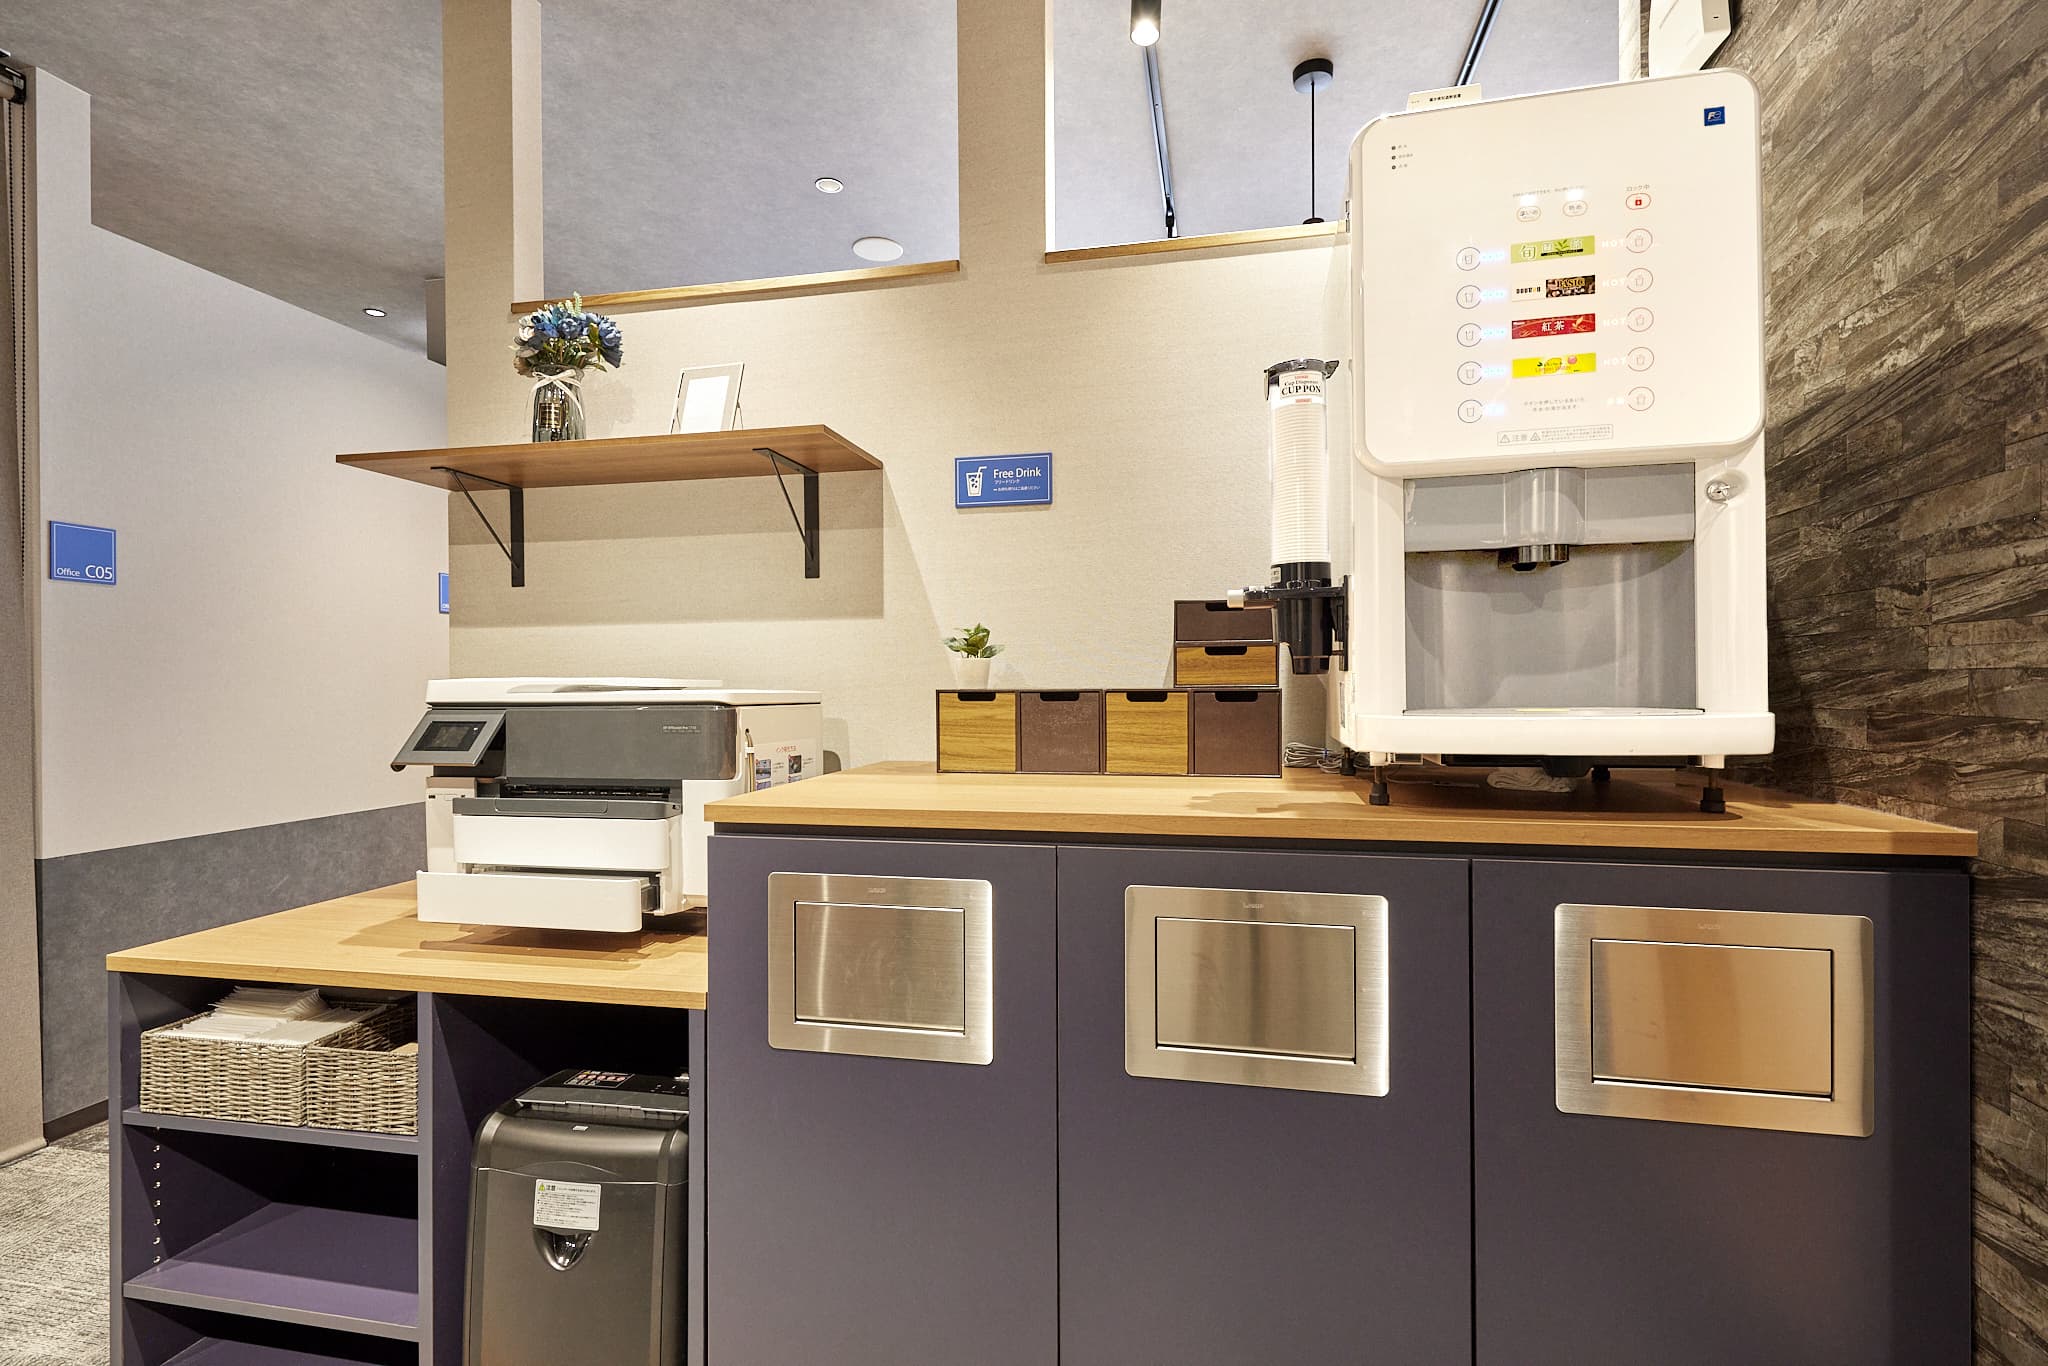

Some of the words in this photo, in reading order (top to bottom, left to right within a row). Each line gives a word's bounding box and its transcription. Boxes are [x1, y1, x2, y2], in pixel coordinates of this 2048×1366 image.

[1541, 320, 1565, 332] 紅茶
[993, 468, 1014, 479] Free
[1016, 466, 1042, 478] Drink
[56, 567, 80, 577] Office
[85, 564, 113, 580] C05
